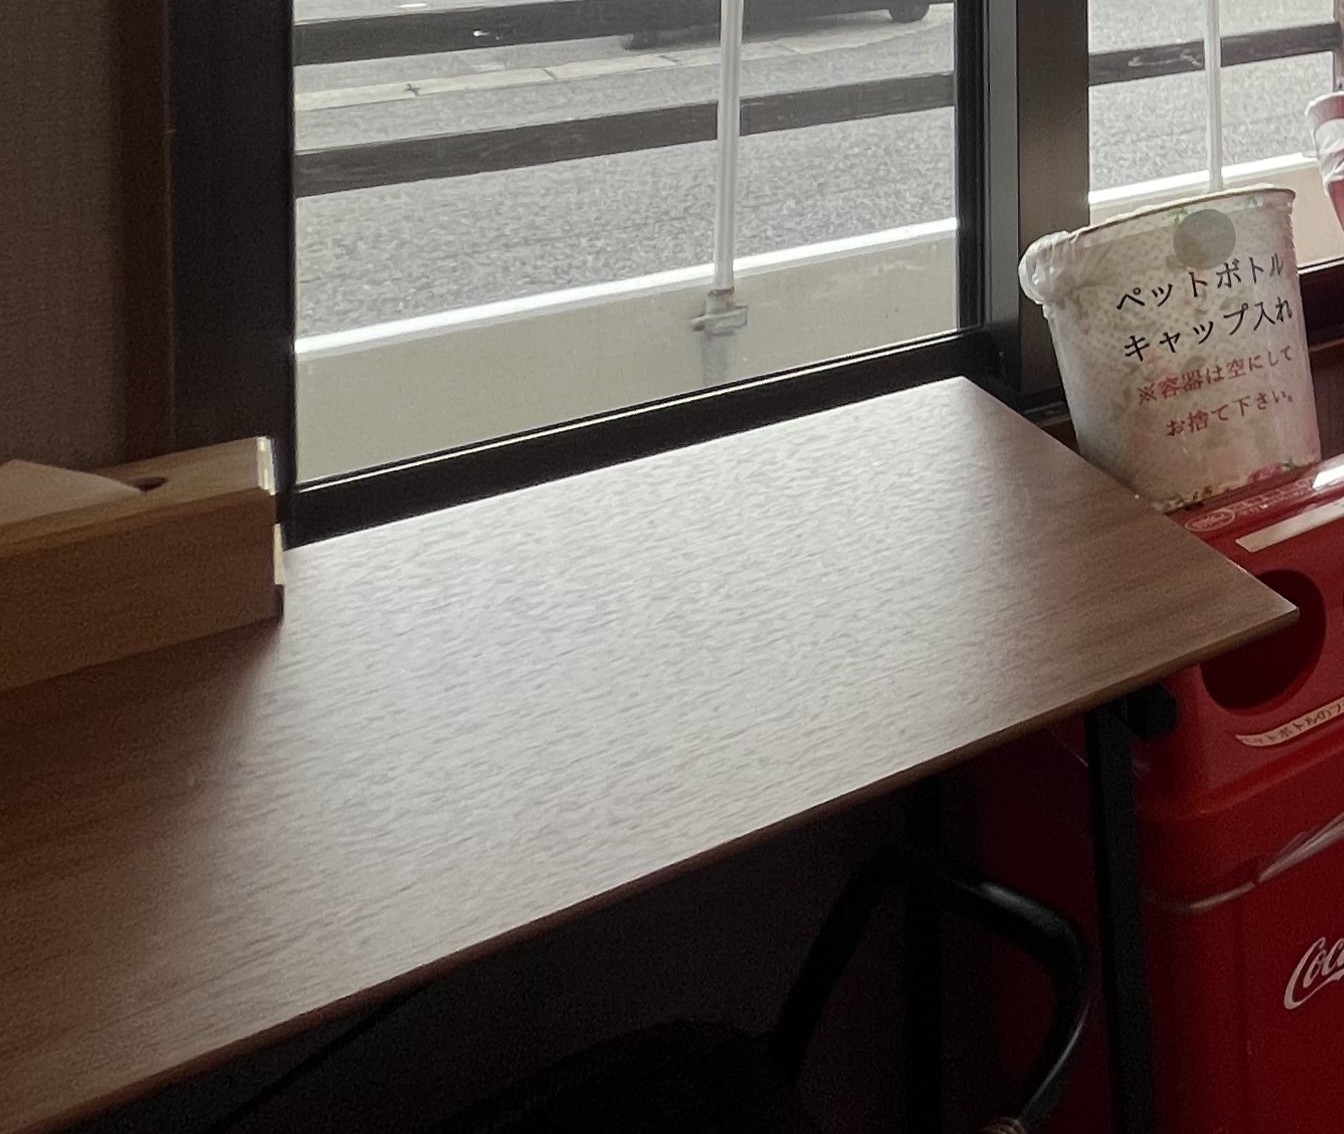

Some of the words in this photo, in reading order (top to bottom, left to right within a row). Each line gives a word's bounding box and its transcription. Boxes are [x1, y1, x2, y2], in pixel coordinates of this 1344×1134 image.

[1115, 252, 1286, 313] ペットボトル
[1123, 297, 1294, 364] キャップ入れ
[1166, 389, 1295, 438] お捨て下さい。
